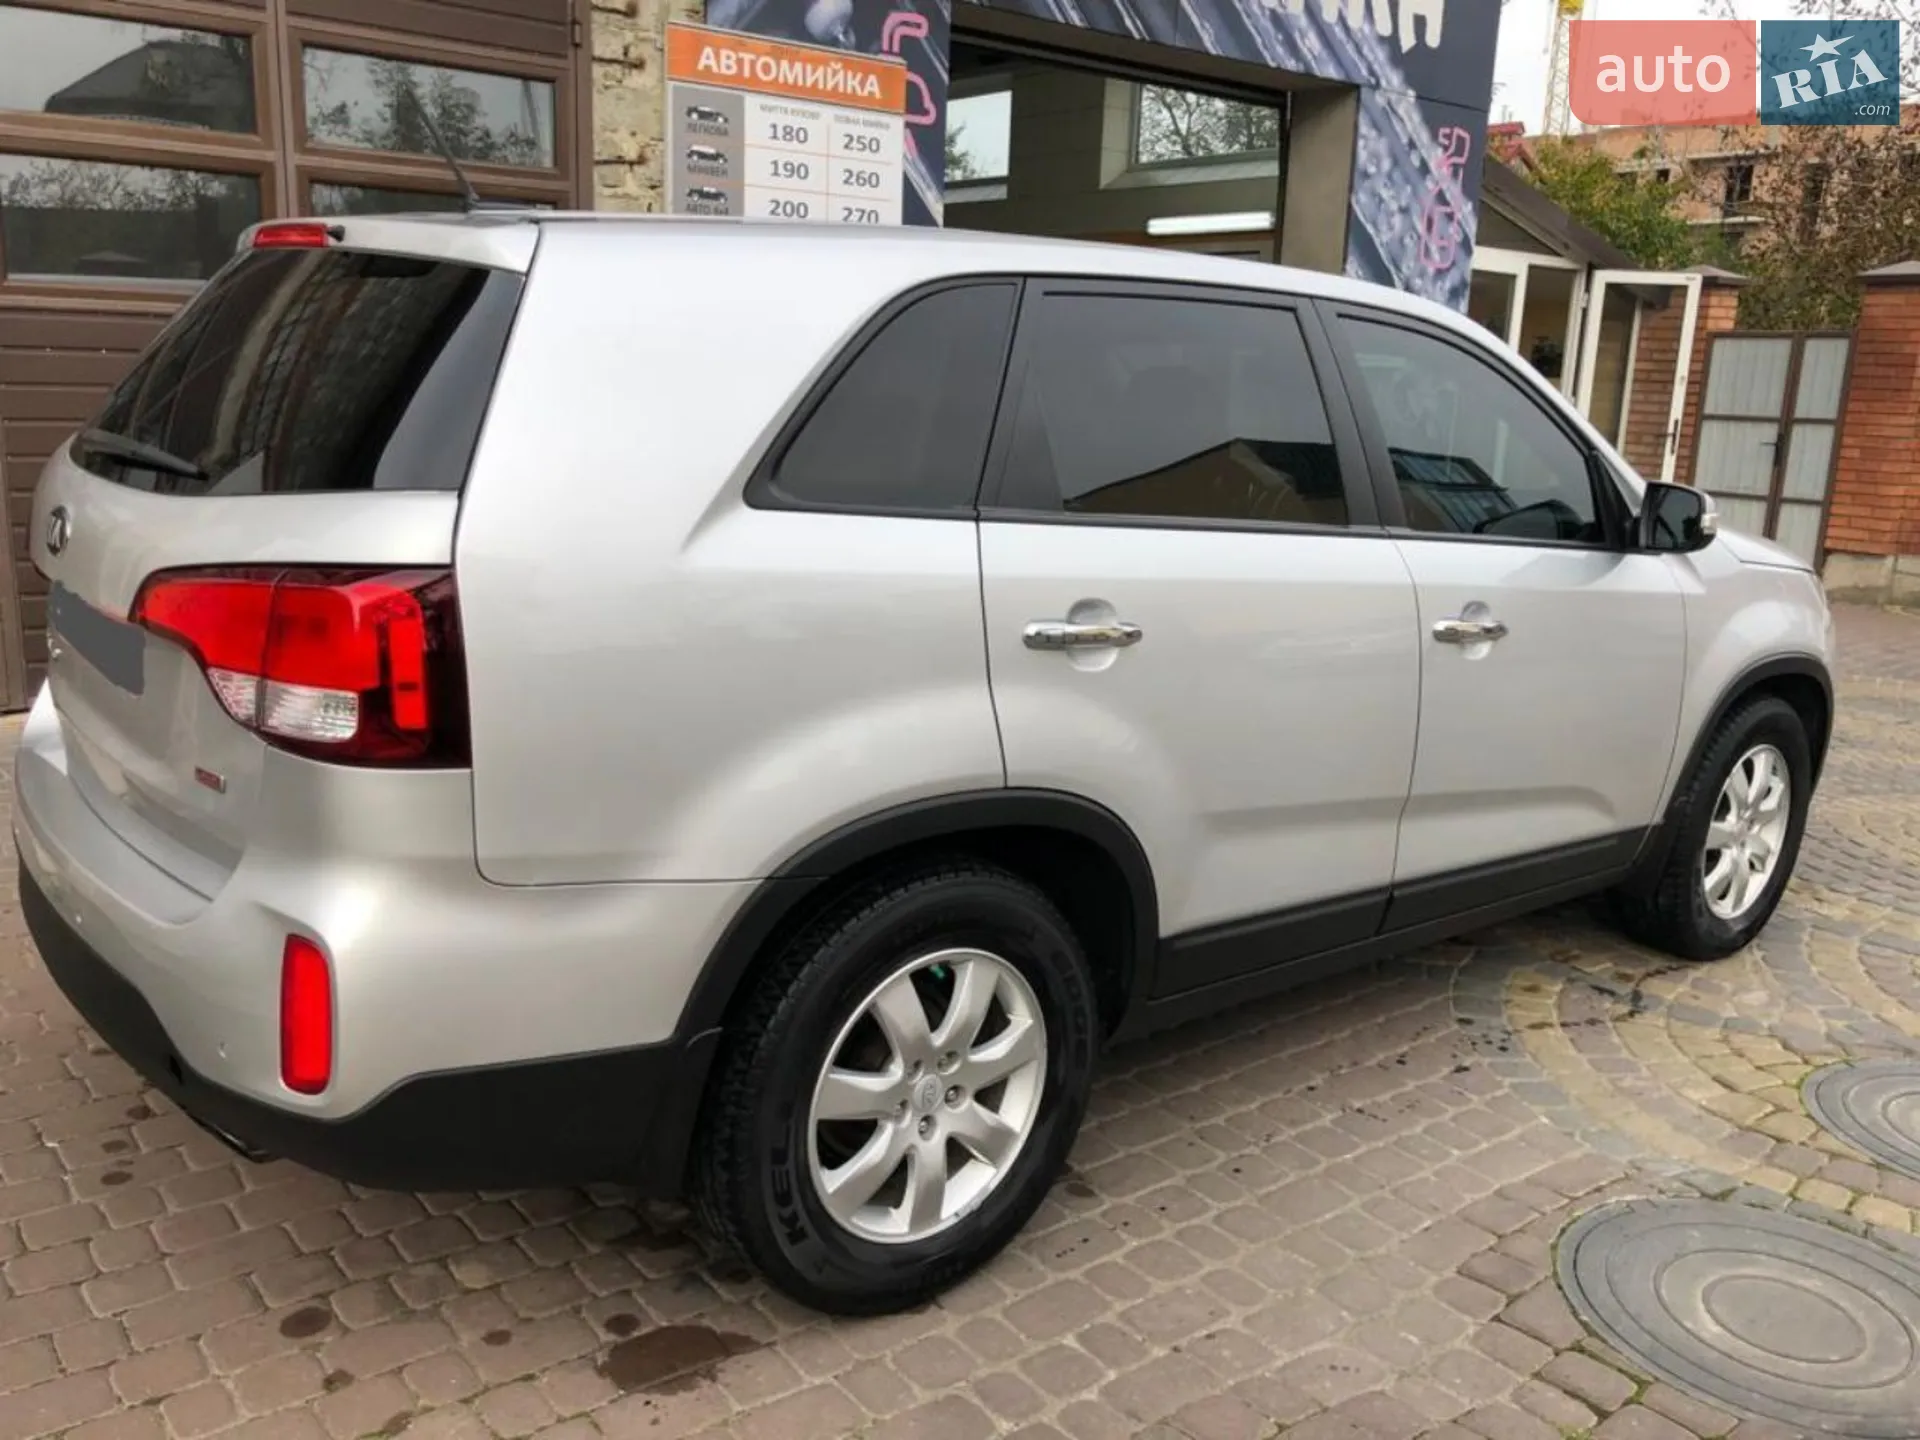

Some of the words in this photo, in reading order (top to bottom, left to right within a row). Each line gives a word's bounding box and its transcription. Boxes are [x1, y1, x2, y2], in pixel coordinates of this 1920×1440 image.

[697, 47, 882, 99] АВТОМИЙКА
[768, 123, 809, 144] 180
[842, 133, 881, 154] 250
[769, 159, 810, 181] 190
[842, 168, 881, 189] 260
[768, 199, 809, 219] 200
[841, 207, 880, 224] 270
